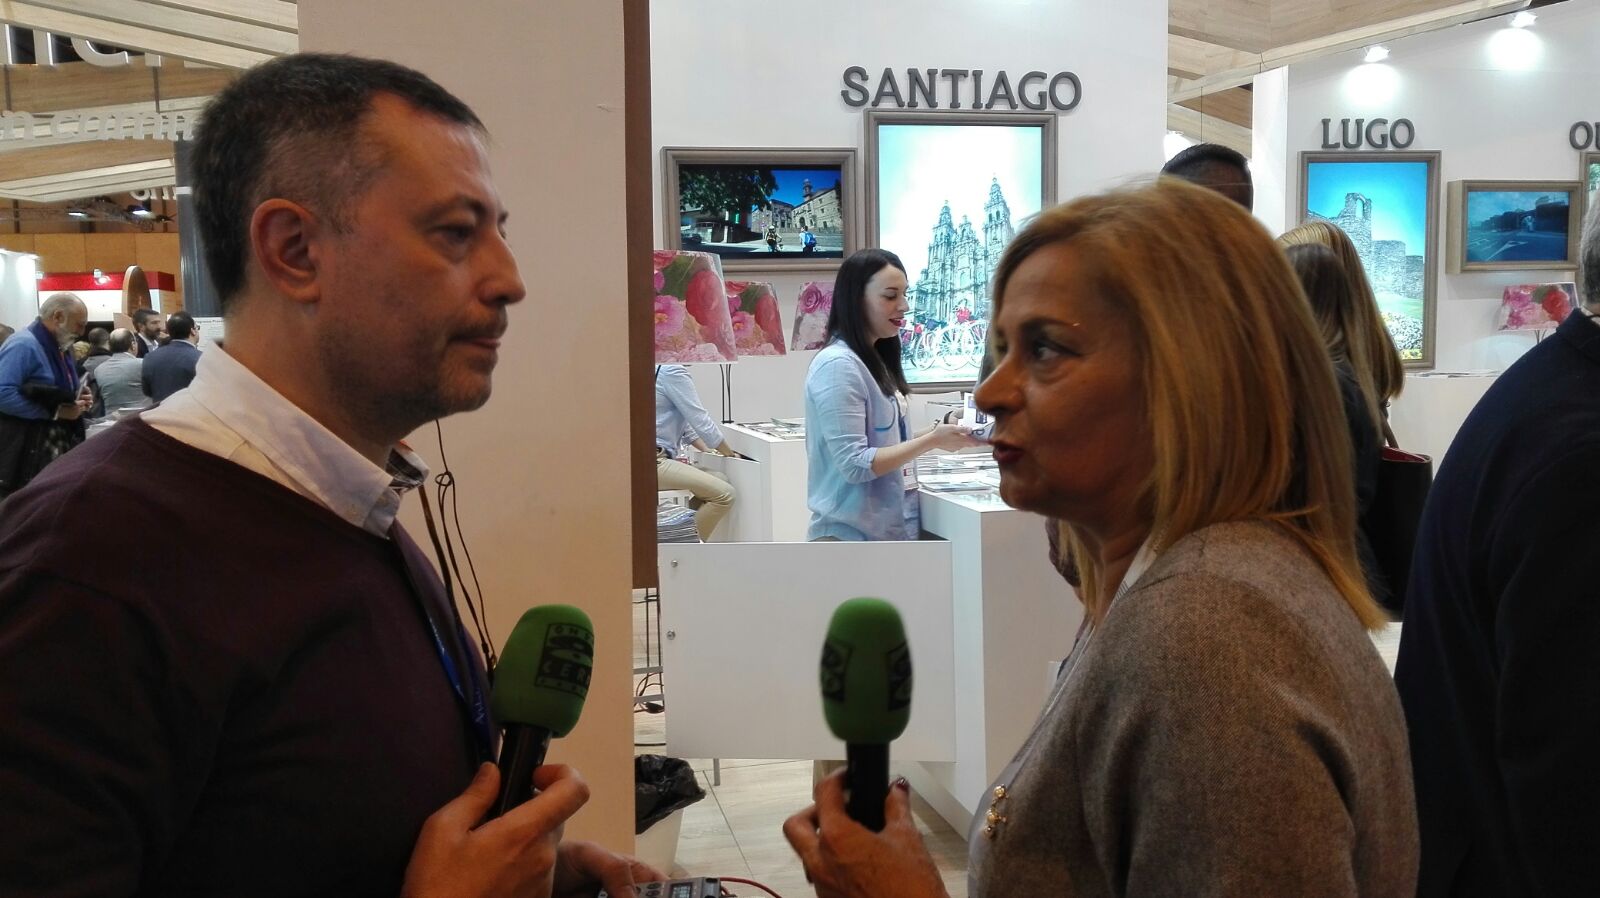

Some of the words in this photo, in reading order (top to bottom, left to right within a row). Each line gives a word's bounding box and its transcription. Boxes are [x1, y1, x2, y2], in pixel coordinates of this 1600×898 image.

[841, 66, 1082, 110] SANTIAGO
[1321, 118, 1415, 149] LUGO
[1569, 121, 1600, 150] O
